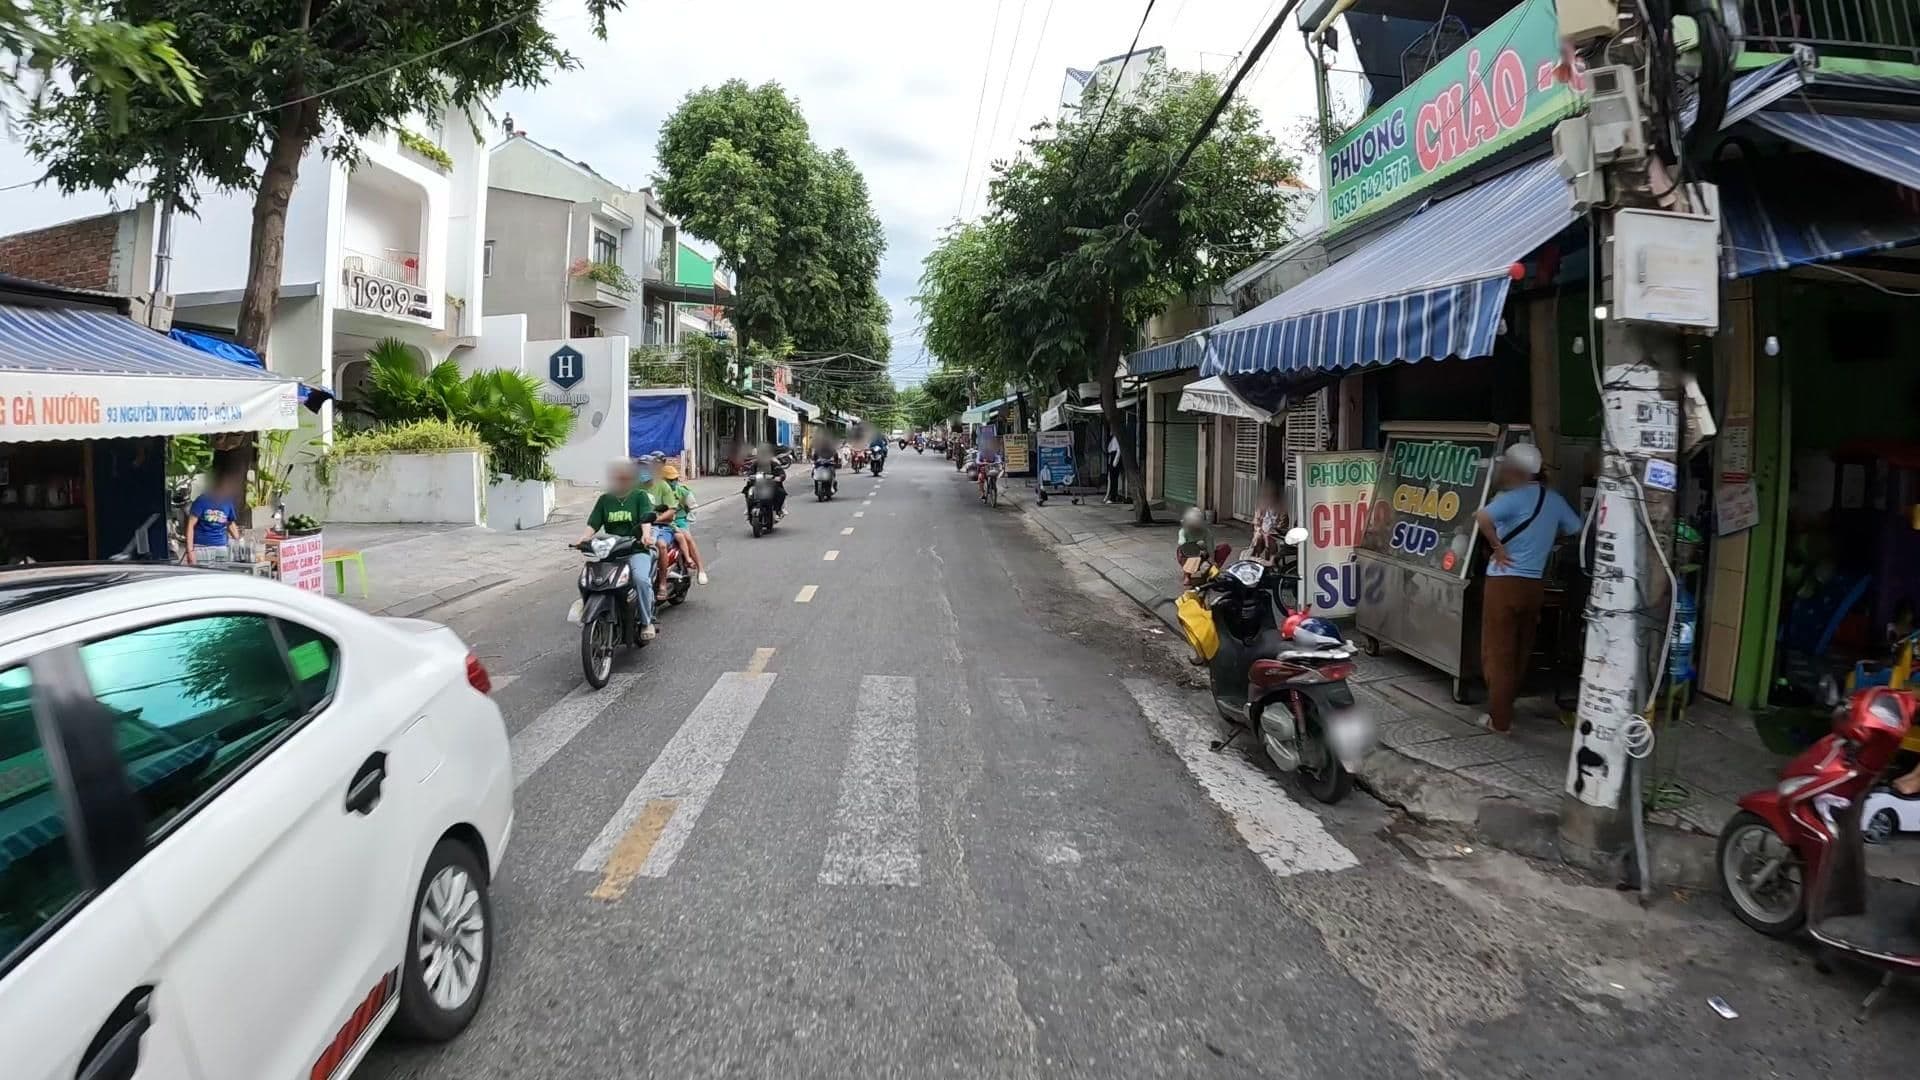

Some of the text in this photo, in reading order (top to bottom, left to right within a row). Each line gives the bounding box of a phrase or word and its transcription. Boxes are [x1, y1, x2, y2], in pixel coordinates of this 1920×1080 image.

[1415, 49, 1527, 173] CHÁO
[1332, 155, 1410, 221] 0935 642 576
[354, 275, 410, 315] 1989
[557, 355, 576, 379] H
[12, 391, 37, 426] GÀ
[42, 391, 101, 425] NƯỚNG
[106, 406, 118, 423] 93
